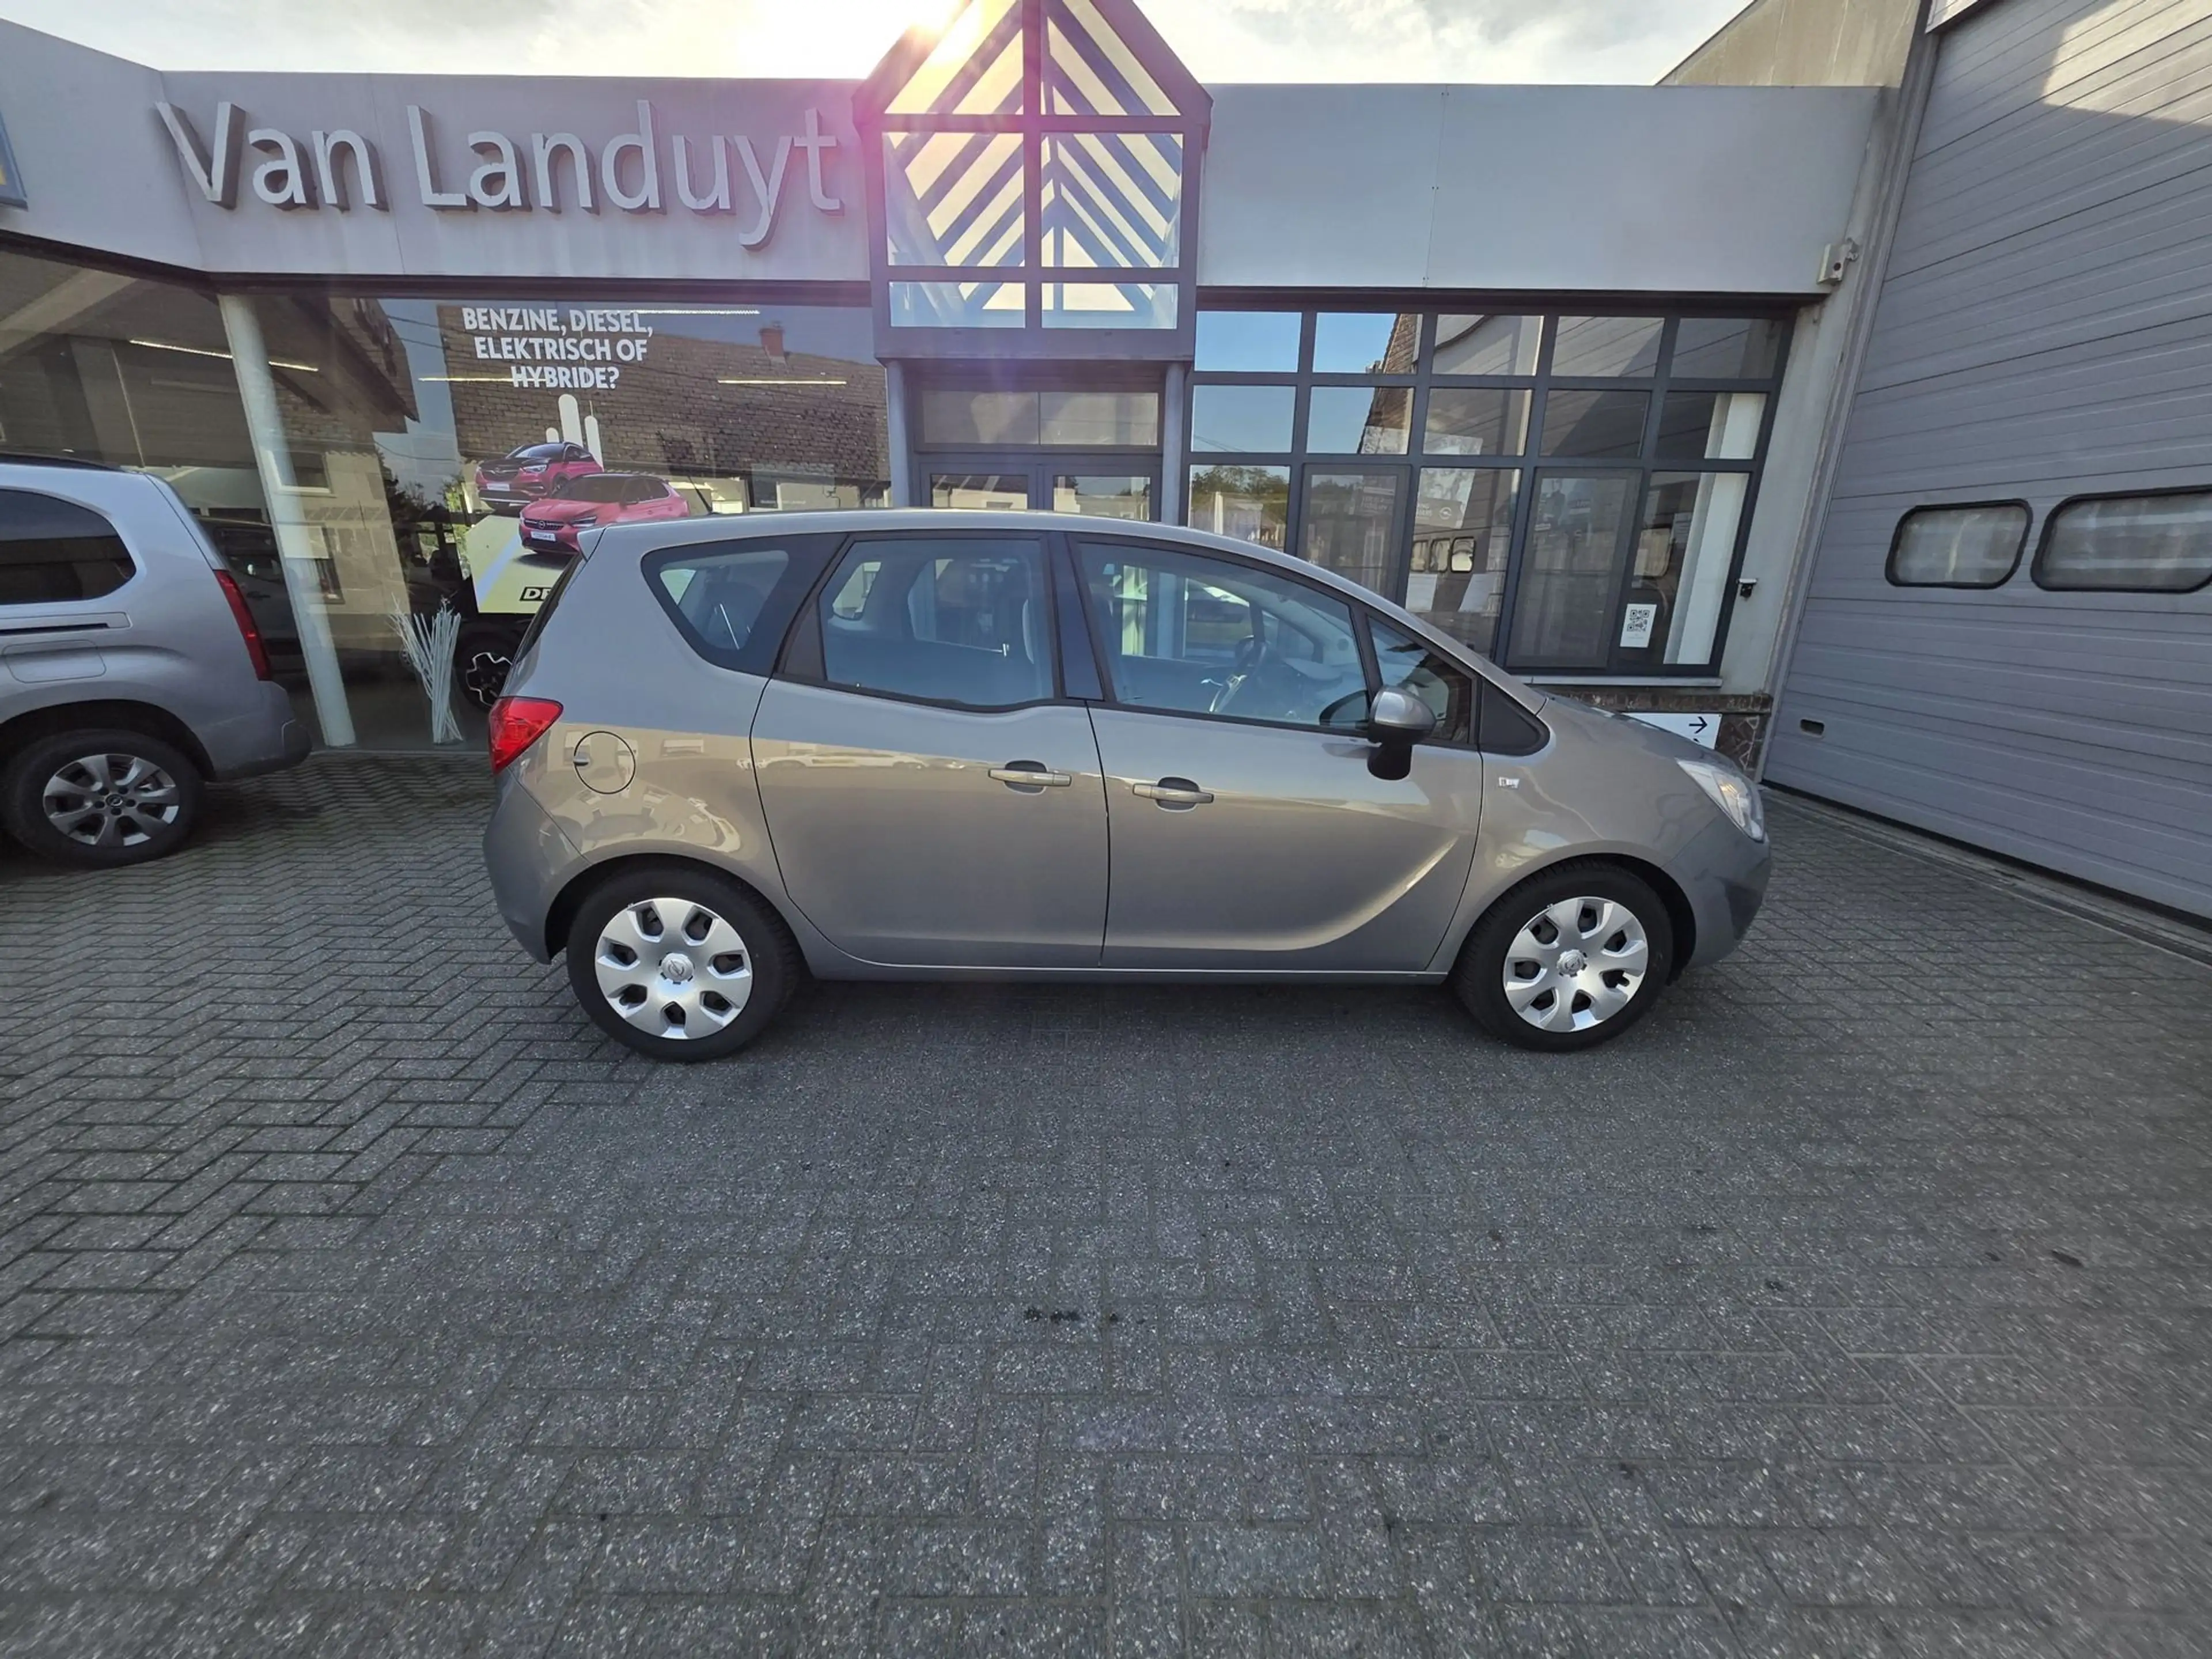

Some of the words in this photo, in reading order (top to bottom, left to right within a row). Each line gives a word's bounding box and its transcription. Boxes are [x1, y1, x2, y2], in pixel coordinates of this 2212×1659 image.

[155, 101, 387, 210] Van
[406, 100, 843, 248] Landuyt
[462, 308, 567, 336] BENZINE,
[569, 309, 653, 337] DIESEL,
[474, 337, 612, 361] ELEKTRISCH
[616, 339, 647, 362] OF
[510, 366, 620, 389] HYBRIDE?
